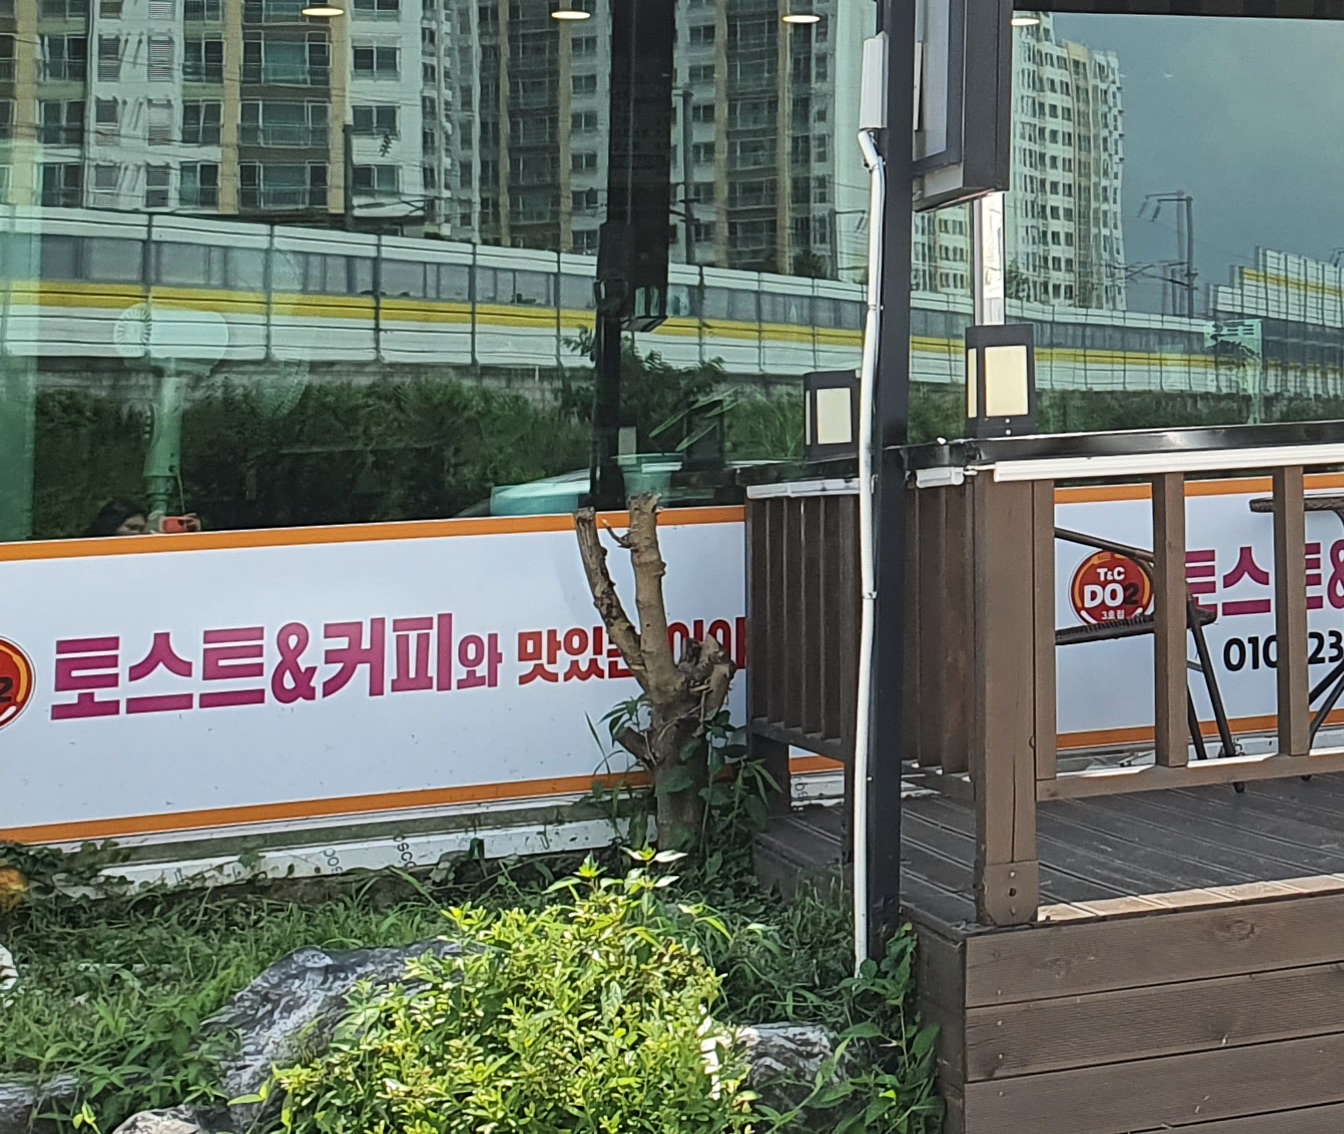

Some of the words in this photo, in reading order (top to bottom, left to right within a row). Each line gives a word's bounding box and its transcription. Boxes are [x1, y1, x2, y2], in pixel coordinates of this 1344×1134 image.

[1096, 566, 1126, 582] T&C
[1083, 582, 1140, 608] DO2
[50, 613, 502, 721] 토스트&커피와
